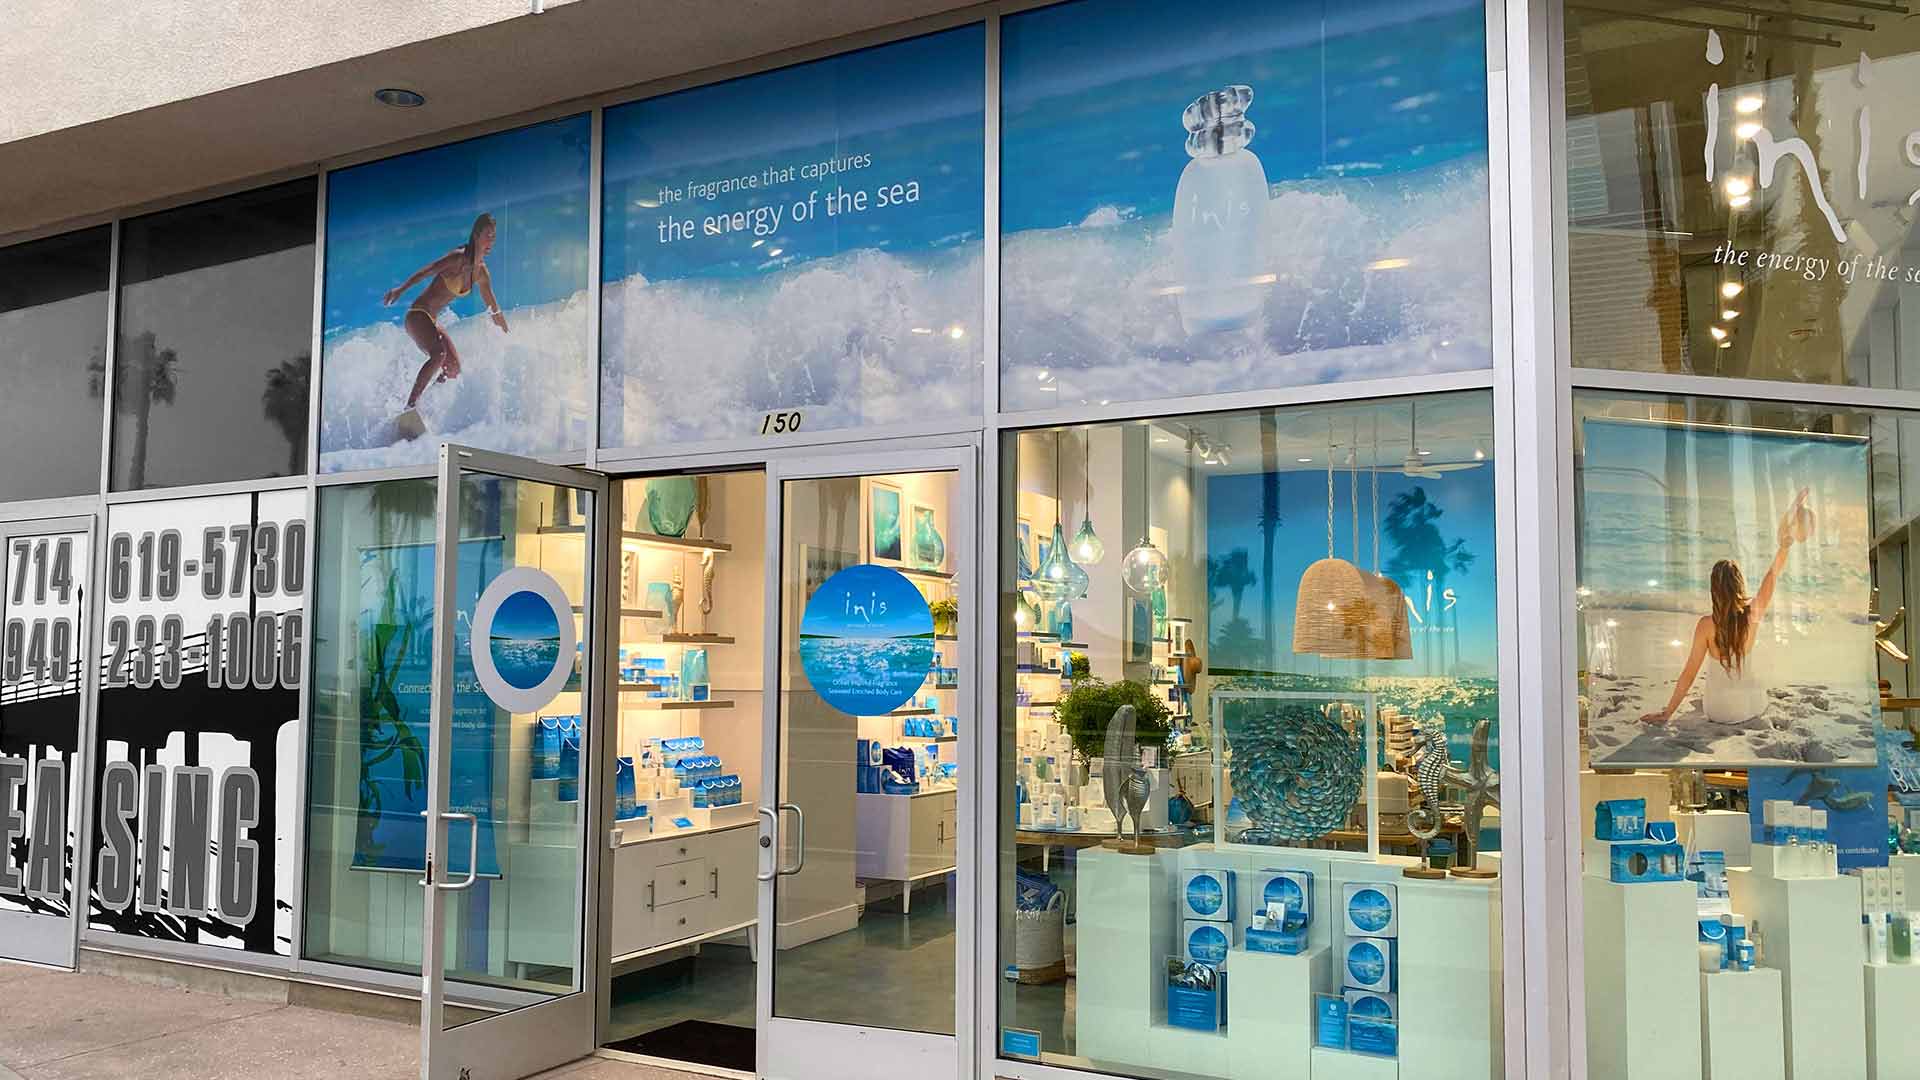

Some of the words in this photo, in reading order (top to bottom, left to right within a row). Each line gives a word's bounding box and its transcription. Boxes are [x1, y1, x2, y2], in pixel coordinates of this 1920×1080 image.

[659, 186, 682, 205] the
[687, 174, 758, 202] fragrance
[763, 165, 795, 187] that
[800, 153, 872, 182] captures
[658, 216, 695, 243] the
[703, 203, 784, 236] energy
[792, 191, 818, 221] of
[825, 185, 868, 217] the
[876, 180, 921, 208] sea
[1713, 240, 1749, 266] the
[1757, 251, 1830, 281] energy
[1837, 254, 1863, 284] of
[1866, 255, 1898, 281] the
[762, 411, 801, 434] 150
[12, 537, 73, 605] 714
[109, 519, 306, 603] 619-5730
[845, 591, 888, 624] inis
[5, 617, 72, 686] 949
[105, 610, 303, 690] 233-1006
[98, 761, 260, 926] SING
